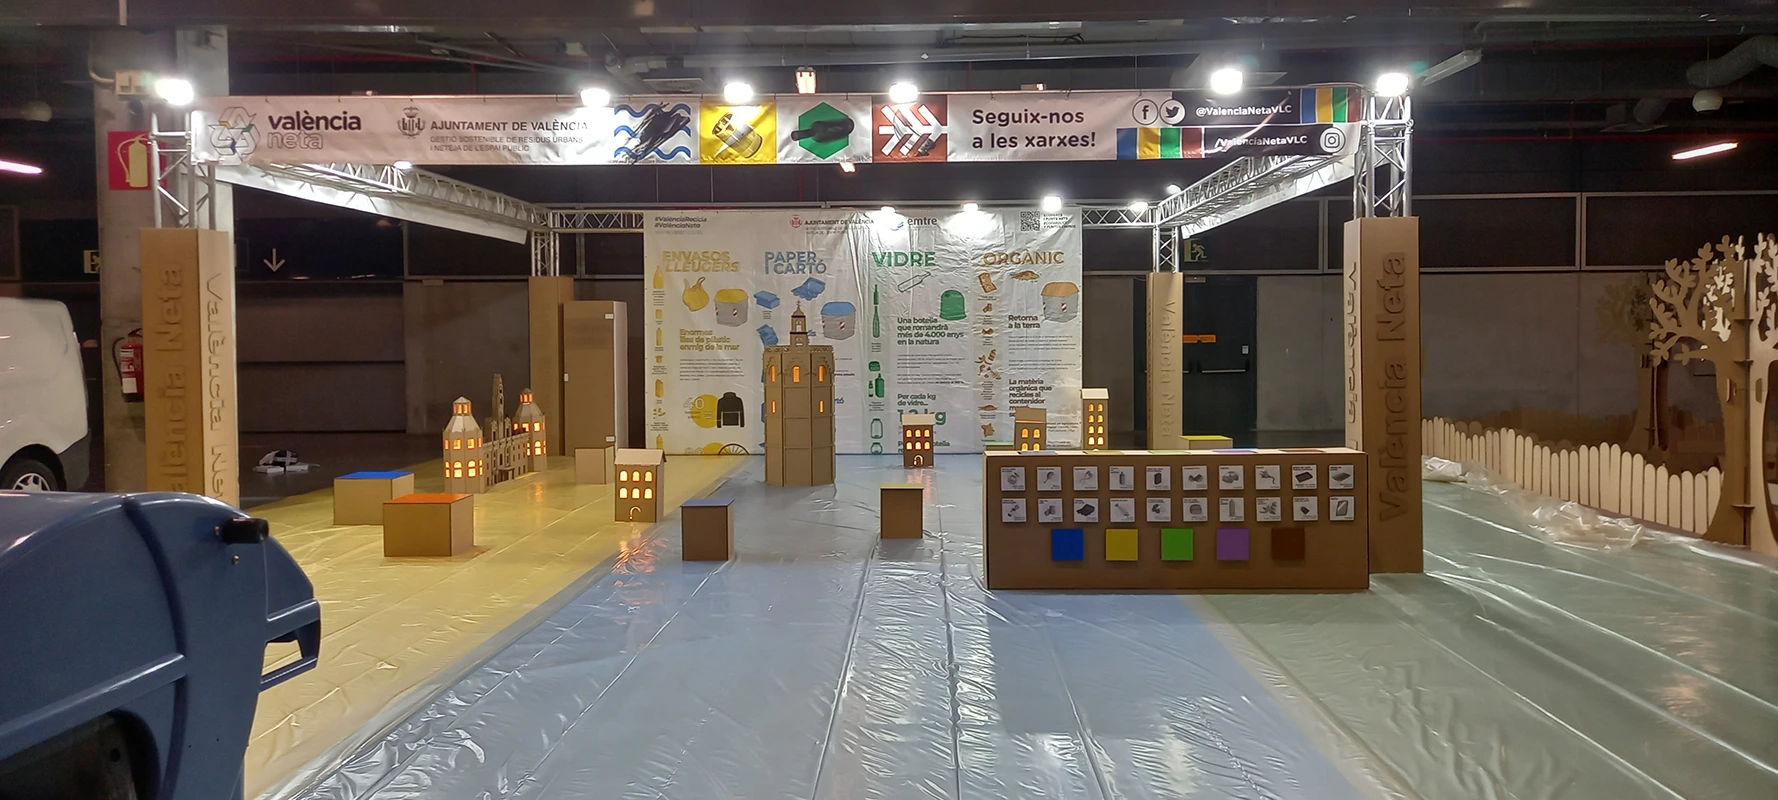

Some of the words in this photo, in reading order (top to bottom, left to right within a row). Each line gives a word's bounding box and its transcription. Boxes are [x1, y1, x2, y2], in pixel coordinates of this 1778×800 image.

[972, 108, 1085, 125] Seguix-nos
[1196, 104, 1292, 118] @ValenciaNetaVLC
[268, 109, 362, 131] valència
[430, 121, 508, 131] AJUNTAMENT
[512, 122, 528, 131] DE
[531, 118, 588, 131] VALÈNCIA
[267, 130, 324, 150] neta
[506, 136, 517, 144] DE
[518, 136, 551, 144] RESIDUS
[972, 136, 983, 149] a
[990, 132, 1018, 149] les
[1024, 132, 1096, 149] xarxes!
[434, 144, 462, 152] NETEJA
[463, 144, 475, 152] DE
[907, 216, 938, 226] emtre
[662, 250, 731, 262] ENVASOS
[764, 251, 818, 263] PAPER
[871, 251, 936, 267] VIDRE
[983, 248, 1065, 265] ORGÀNIC
[665, 261, 740, 272] LLEUGERS
[774, 260, 827, 275] CARTÓ
[1375, 252, 1406, 342] Neta
[1008, 314, 1038, 322] Retorna
[927, 393, 937, 401] kg
